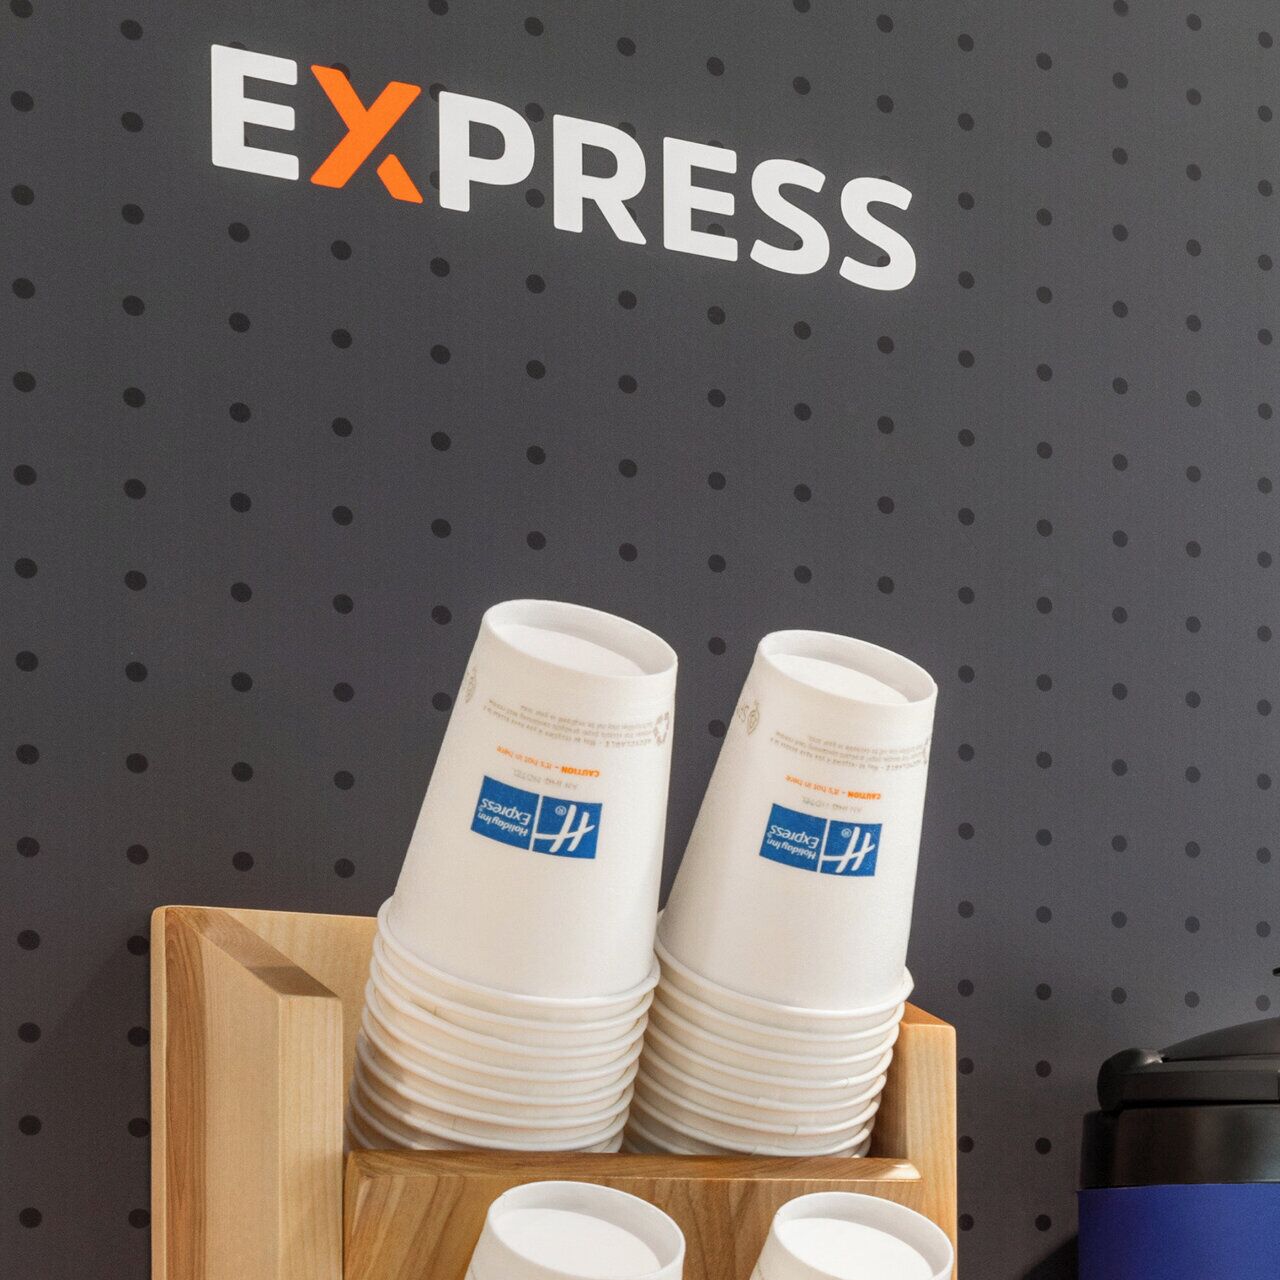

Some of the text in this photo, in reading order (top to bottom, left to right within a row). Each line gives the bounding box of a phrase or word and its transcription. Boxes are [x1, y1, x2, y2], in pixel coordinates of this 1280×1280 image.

[210, 43, 917, 291] EXPRESS
[561, 765, 600, 778] CAUTION
[848, 790, 881, 801] CAUTION
[481, 797, 531, 826] Express
[477, 811, 528, 838] Holiday Inn
[770, 824, 820, 849] Express
[766, 838, 817, 861] Holiday Inn
